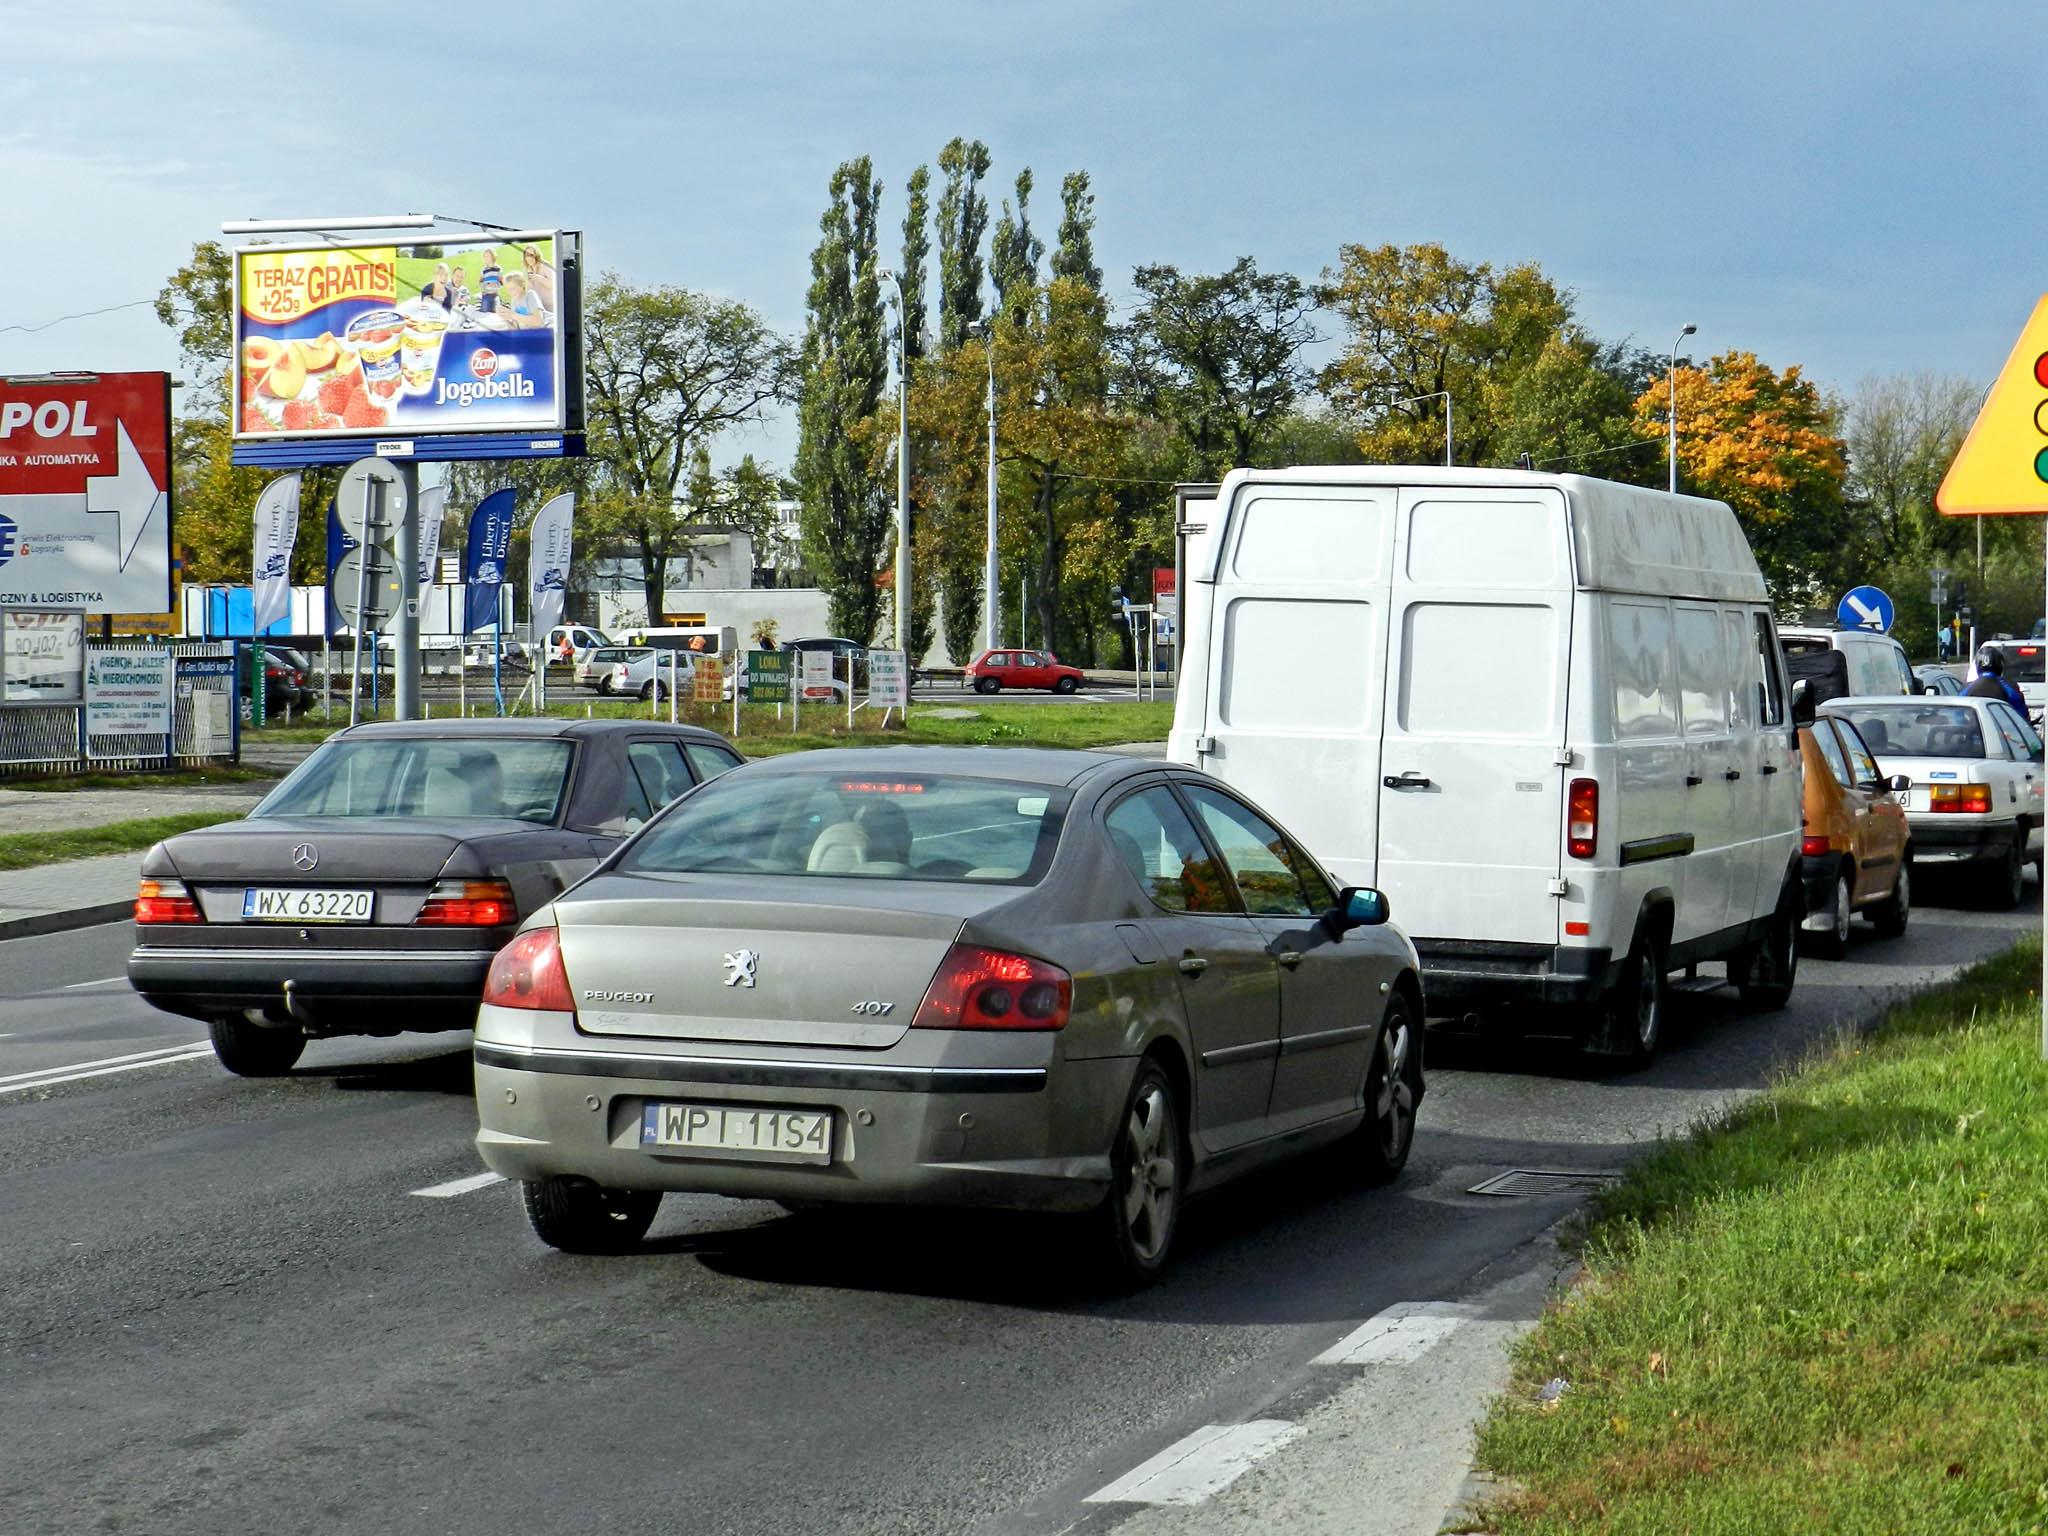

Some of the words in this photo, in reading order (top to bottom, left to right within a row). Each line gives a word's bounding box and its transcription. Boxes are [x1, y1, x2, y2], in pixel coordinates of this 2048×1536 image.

[254, 268, 305, 288] TERAZ
[307, 262, 395, 304] GRATIS!
[435, 372, 535, 407] Jogobella
[0, 400, 97, 438] POL
[25, 453, 100, 466] AUTOMATYKA
[497, 520, 510, 559] Direct
[560, 527, 570, 564] Direct
[0, 593, 28, 603] CZNY
[31, 593, 38, 602] &
[41, 592, 104, 603] LOGISTYKA
[100, 656, 132, 668] AGENCJA
[229, 659, 235, 671] 2
[750, 672, 759, 682] DO
[259, 892, 291, 914] WX
[298, 892, 368, 915] 63220
[584, 990, 655, 1003] PEUGEOT
[850, 1001, 896, 1016] 407
[644, 1126, 656, 1136] PL
[665, 1106, 727, 1144] WPI
[749, 1112, 826, 1150] 11S4
